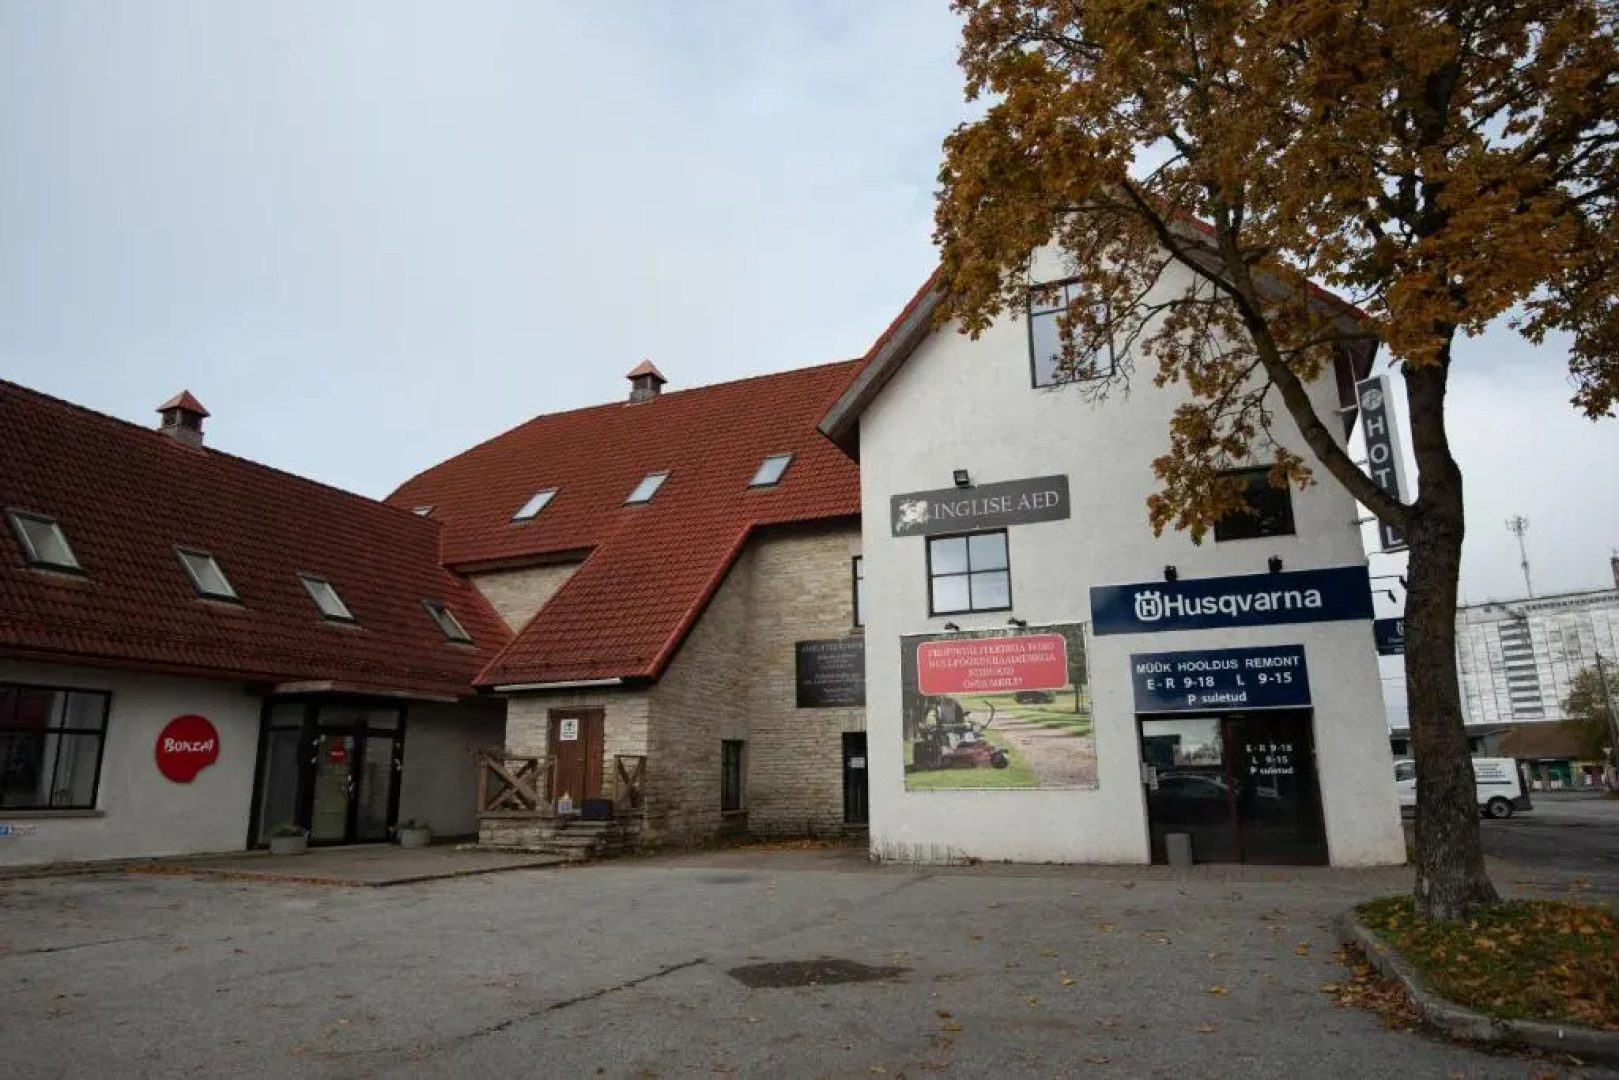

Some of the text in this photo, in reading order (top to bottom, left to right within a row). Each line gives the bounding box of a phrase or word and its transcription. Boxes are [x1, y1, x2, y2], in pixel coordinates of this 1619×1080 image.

[1365, 414, 1403, 547] HOTL
[934, 490, 1059, 519] INGLISE AED
[1164, 588, 1323, 618] Husqvarna
[1136, 656, 1300, 673] MÜÜK HOOLDUS REMONT
[1183, 676, 1215, 689] 9-18
[1236, 673, 1245, 686] L
[1258, 671, 1293, 684] 9-15
[1187, 692, 1247, 705] P suletud
